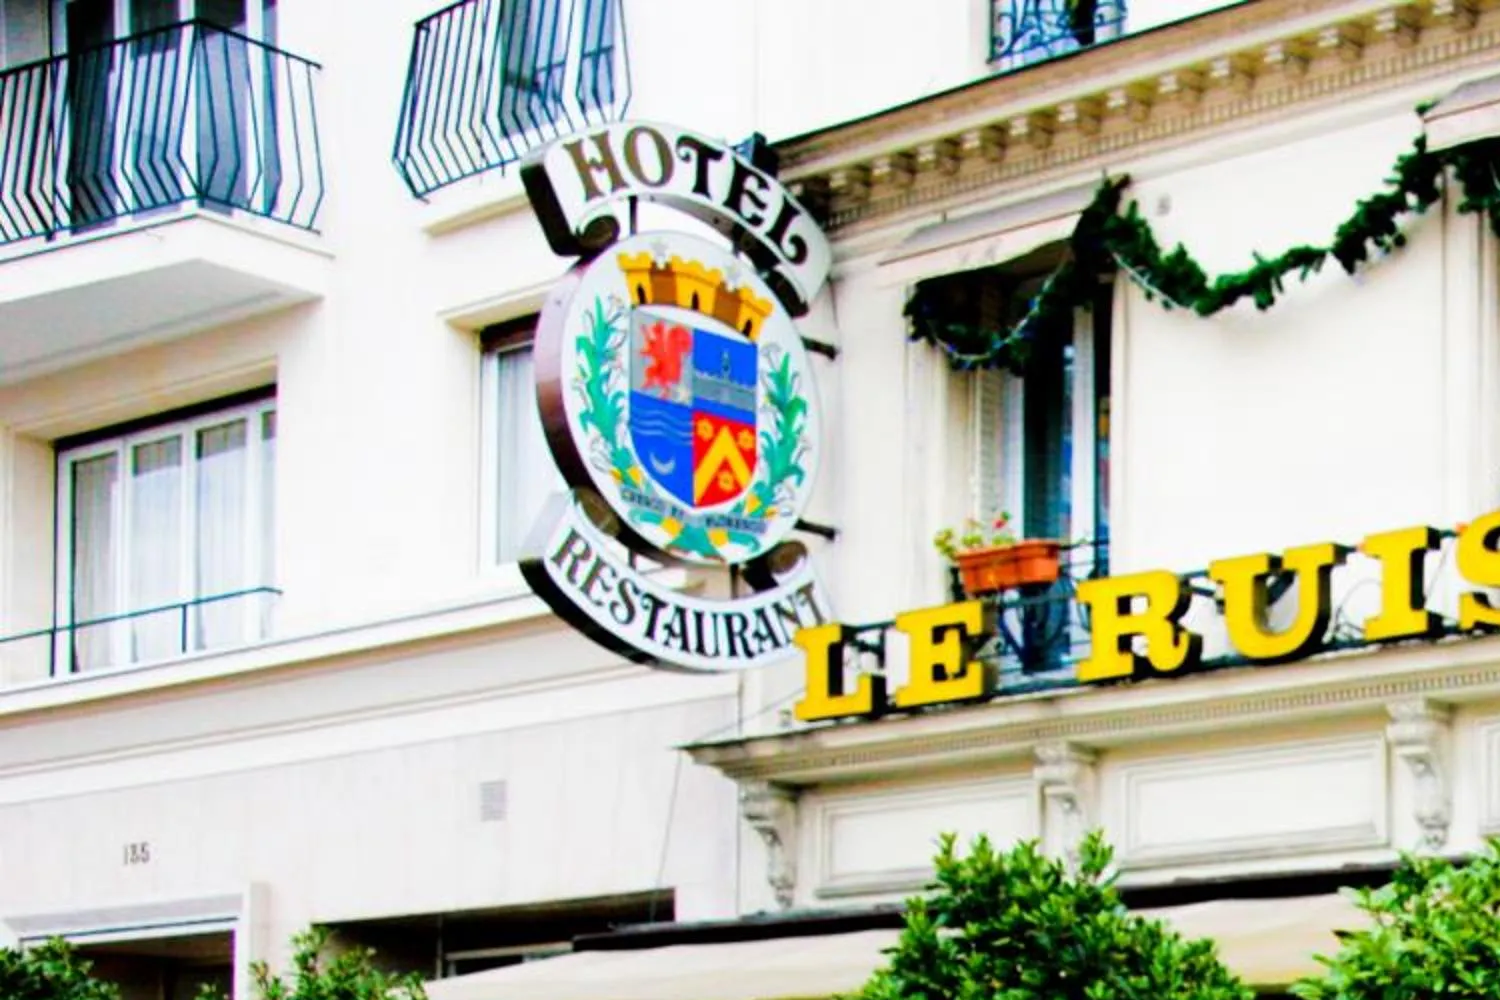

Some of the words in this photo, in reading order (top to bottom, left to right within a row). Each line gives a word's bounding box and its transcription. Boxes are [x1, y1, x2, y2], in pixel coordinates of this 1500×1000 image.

[562, 125, 808, 266] HOTEL
[551, 527, 827, 659] RESTAURANT
[793, 601, 990, 724] LE
